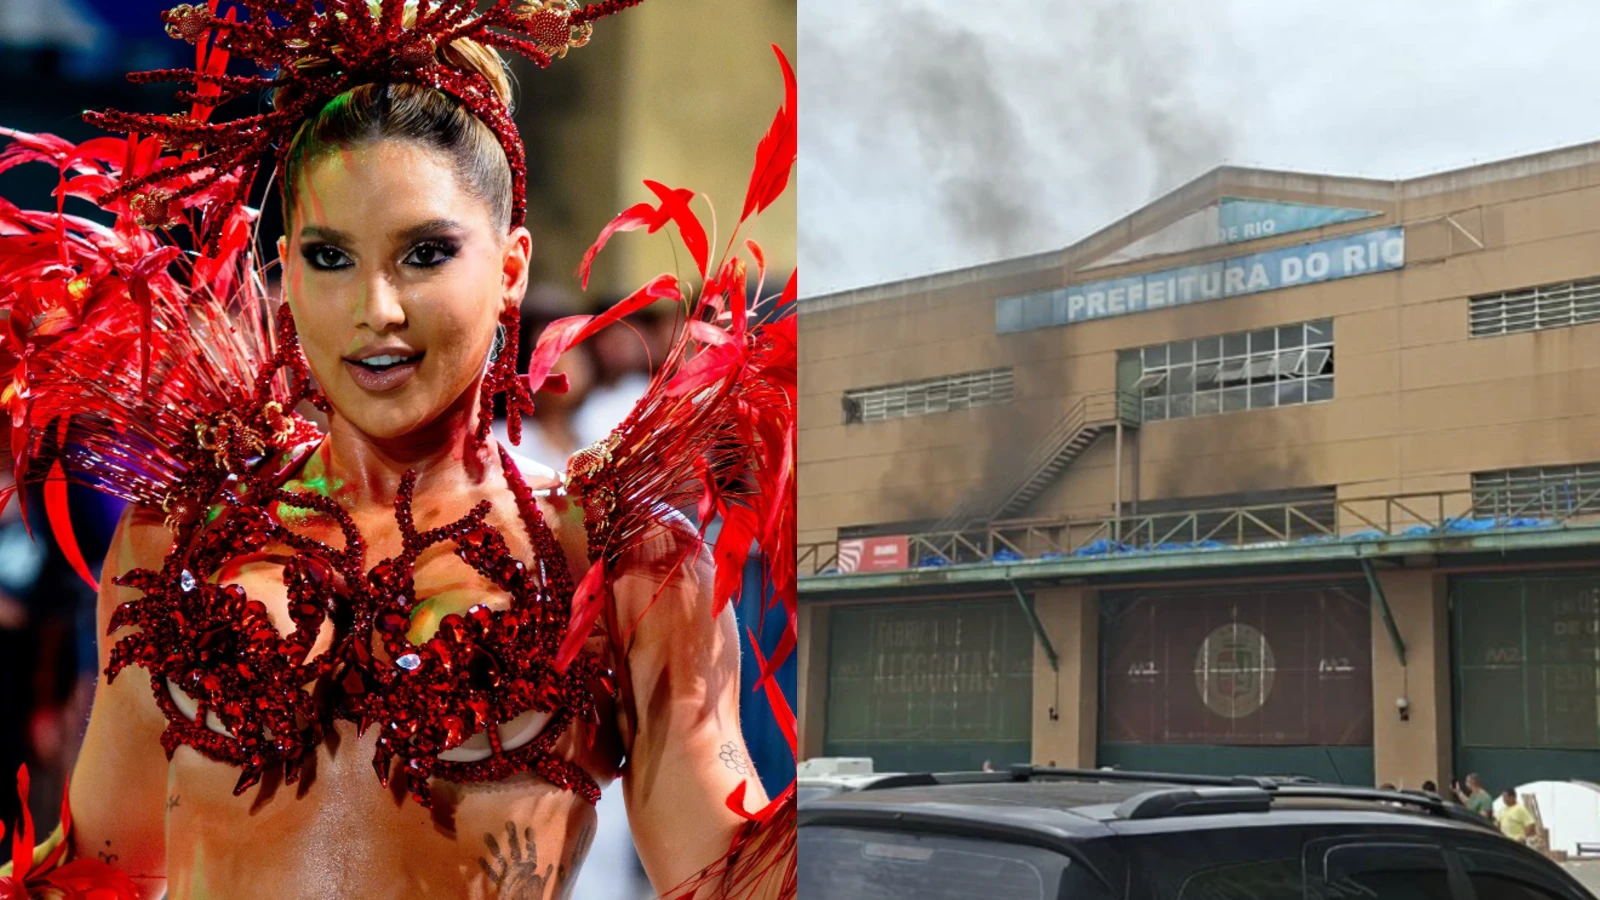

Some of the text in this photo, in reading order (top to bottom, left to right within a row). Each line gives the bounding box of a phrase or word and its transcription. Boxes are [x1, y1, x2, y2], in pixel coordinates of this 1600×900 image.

[1244, 219, 1276, 237] RIO
[1067, 237, 1404, 323] PREFEITURA DO RIO
